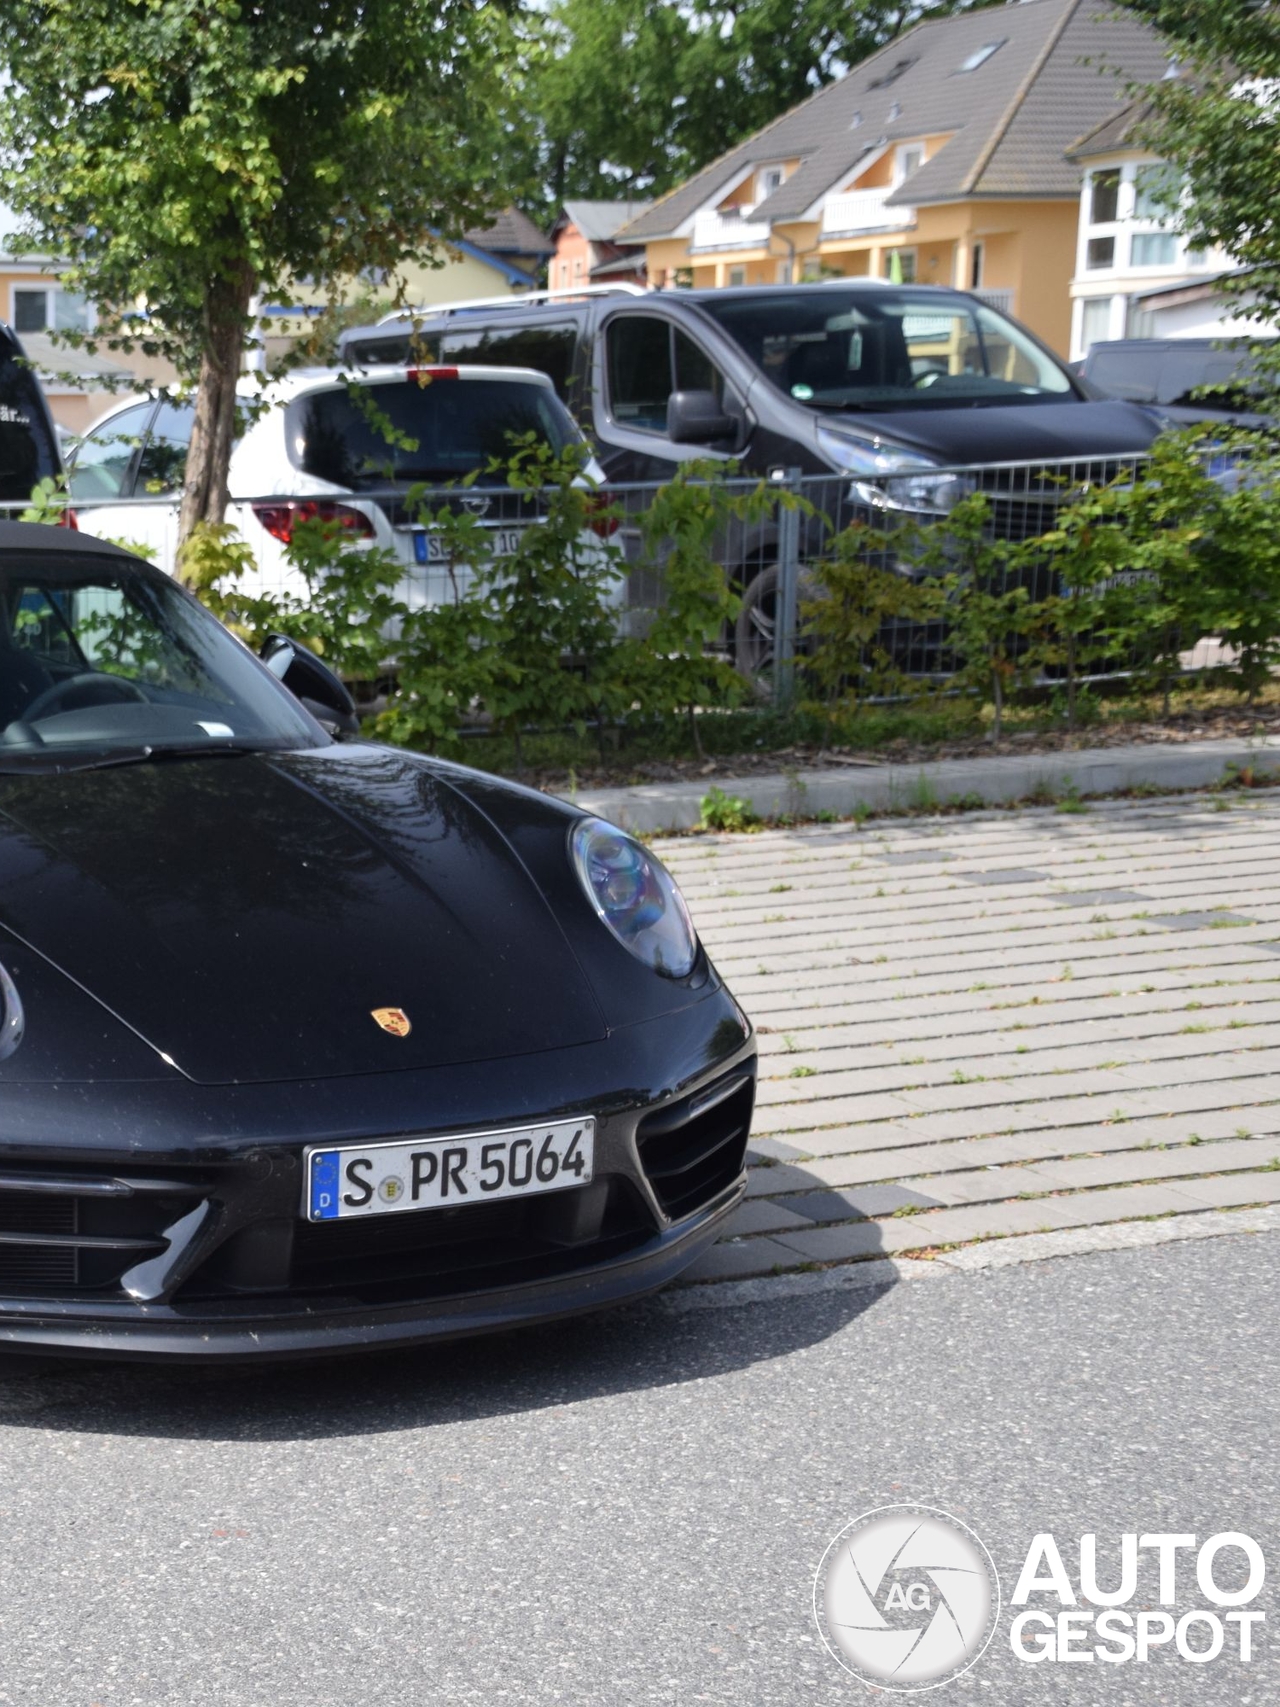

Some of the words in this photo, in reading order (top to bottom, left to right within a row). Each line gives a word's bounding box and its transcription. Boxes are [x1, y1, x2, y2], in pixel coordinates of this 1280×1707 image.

[343, 1158, 373, 1207] S
[410, 1147, 468, 1200] PR
[479, 1130, 585, 1192] 5064
[320, 1193, 331, 1208] D
